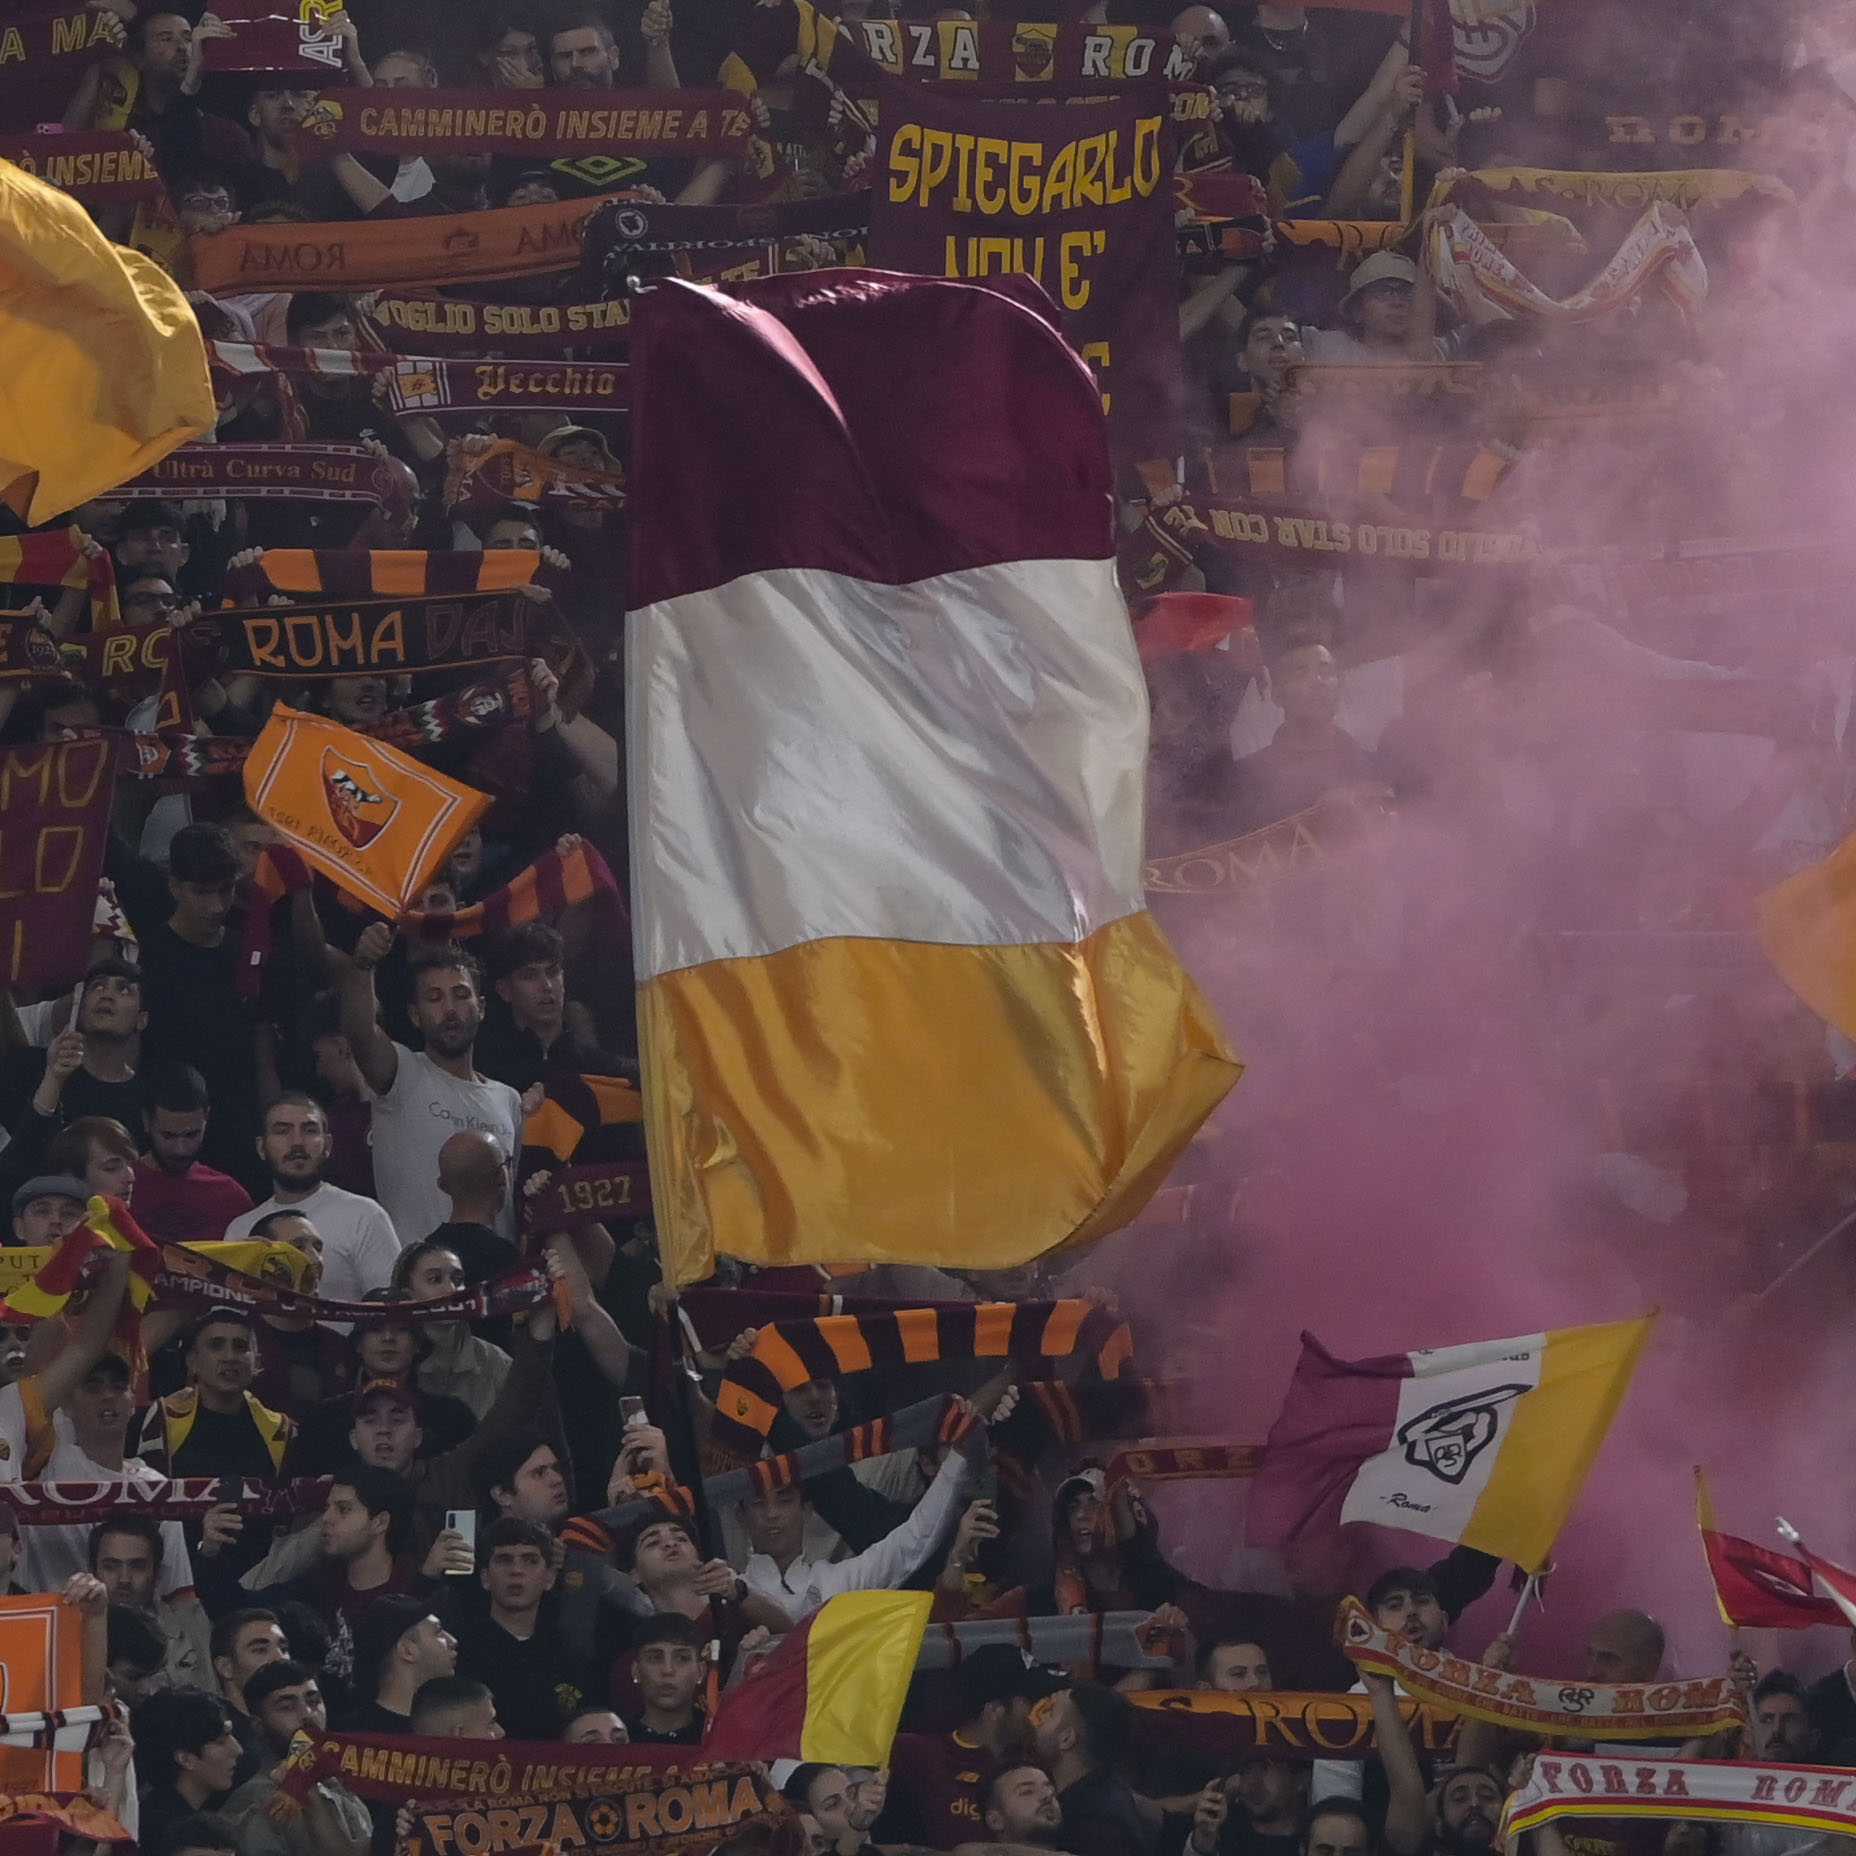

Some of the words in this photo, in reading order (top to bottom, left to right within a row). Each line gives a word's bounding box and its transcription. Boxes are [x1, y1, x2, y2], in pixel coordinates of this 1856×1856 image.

[360, 103, 546, 139] CAMMINERÒ
[556, 109, 683, 140] INSIEME
[687, 109, 710, 139] A
[888, 115, 1163, 217] SPIEGARLO
[484, 305, 561, 334] SOLO
[474, 365, 616, 400] Vecchio
[225, 456, 303, 483] Curva
[310, 460, 357, 485] Sud
[1358, 523, 1431, 560] SOLO
[244, 612, 406, 666] ROMA
[557, 1174, 634, 1212] 1927
[1540, 1760, 1690, 1798] FORZA
[423, 1802, 587, 1853] FORZA
[624, 1776, 763, 1841] ROMA
